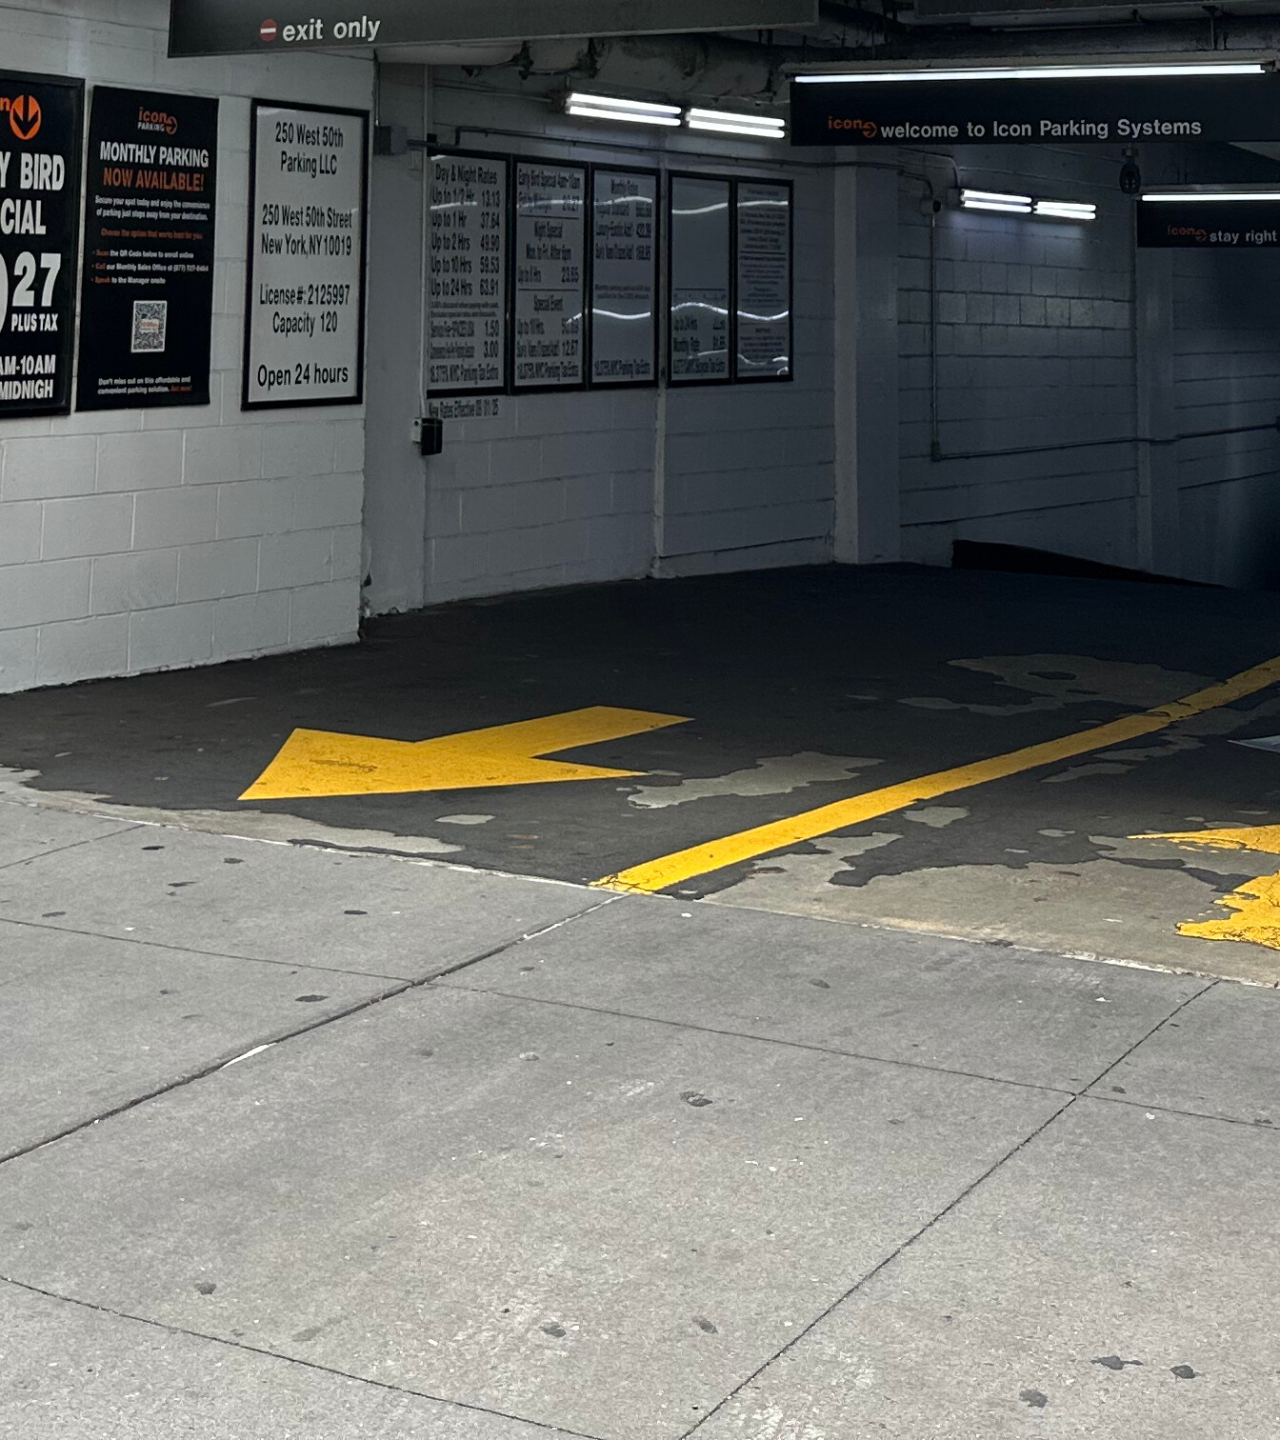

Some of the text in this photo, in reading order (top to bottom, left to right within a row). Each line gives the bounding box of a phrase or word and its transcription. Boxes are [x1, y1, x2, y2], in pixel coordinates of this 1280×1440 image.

[282, 15, 380, 41] exit only
[138, 106, 167, 123] icon
[275, 121, 343, 148] 250 West 50th
[827, 115, 1202, 140] icon welcome to Icon Parking Systems
[100, 141, 209, 168] MONTHLY PARKING
[281, 151, 337, 178] Parking LLC
[20, 152, 65, 191] BIRD
[103, 167, 204, 192] NOW AVAILABLE!
[436, 164, 449, 185] Day
[458, 165, 476, 187] Night
[478, 166, 497, 185] Rates
[262, 203, 352, 229] 250 West 50th Street
[432, 211, 442, 231] Up
[443, 211, 451, 228] to
[458, 211, 467, 228] Hr
[261, 232, 283, 254] New
[324, 235, 352, 256] 10019
[431, 232, 441, 253] Up
[443, 233, 450, 250] to
[458, 233, 470, 251] Hrs
[1209, 230, 1240, 245] stay
[1245, 229, 1277, 245] right
[431, 255, 441, 276] Up
[443, 256, 450, 273] to
[460, 256, 472, 274] Hrs
[12, 252, 61, 307] 27
[431, 279, 440, 299] Up
[442, 280, 450, 295] to
[451, 278, 459, 295] 24
[461, 279, 472, 295] Hrs
[307, 283, 350, 305] 2125997
[11, 313, 58, 332] PLUS TAX
[273, 311, 338, 338] Capacity 120
[257, 363, 348, 391] Open 24 hours
